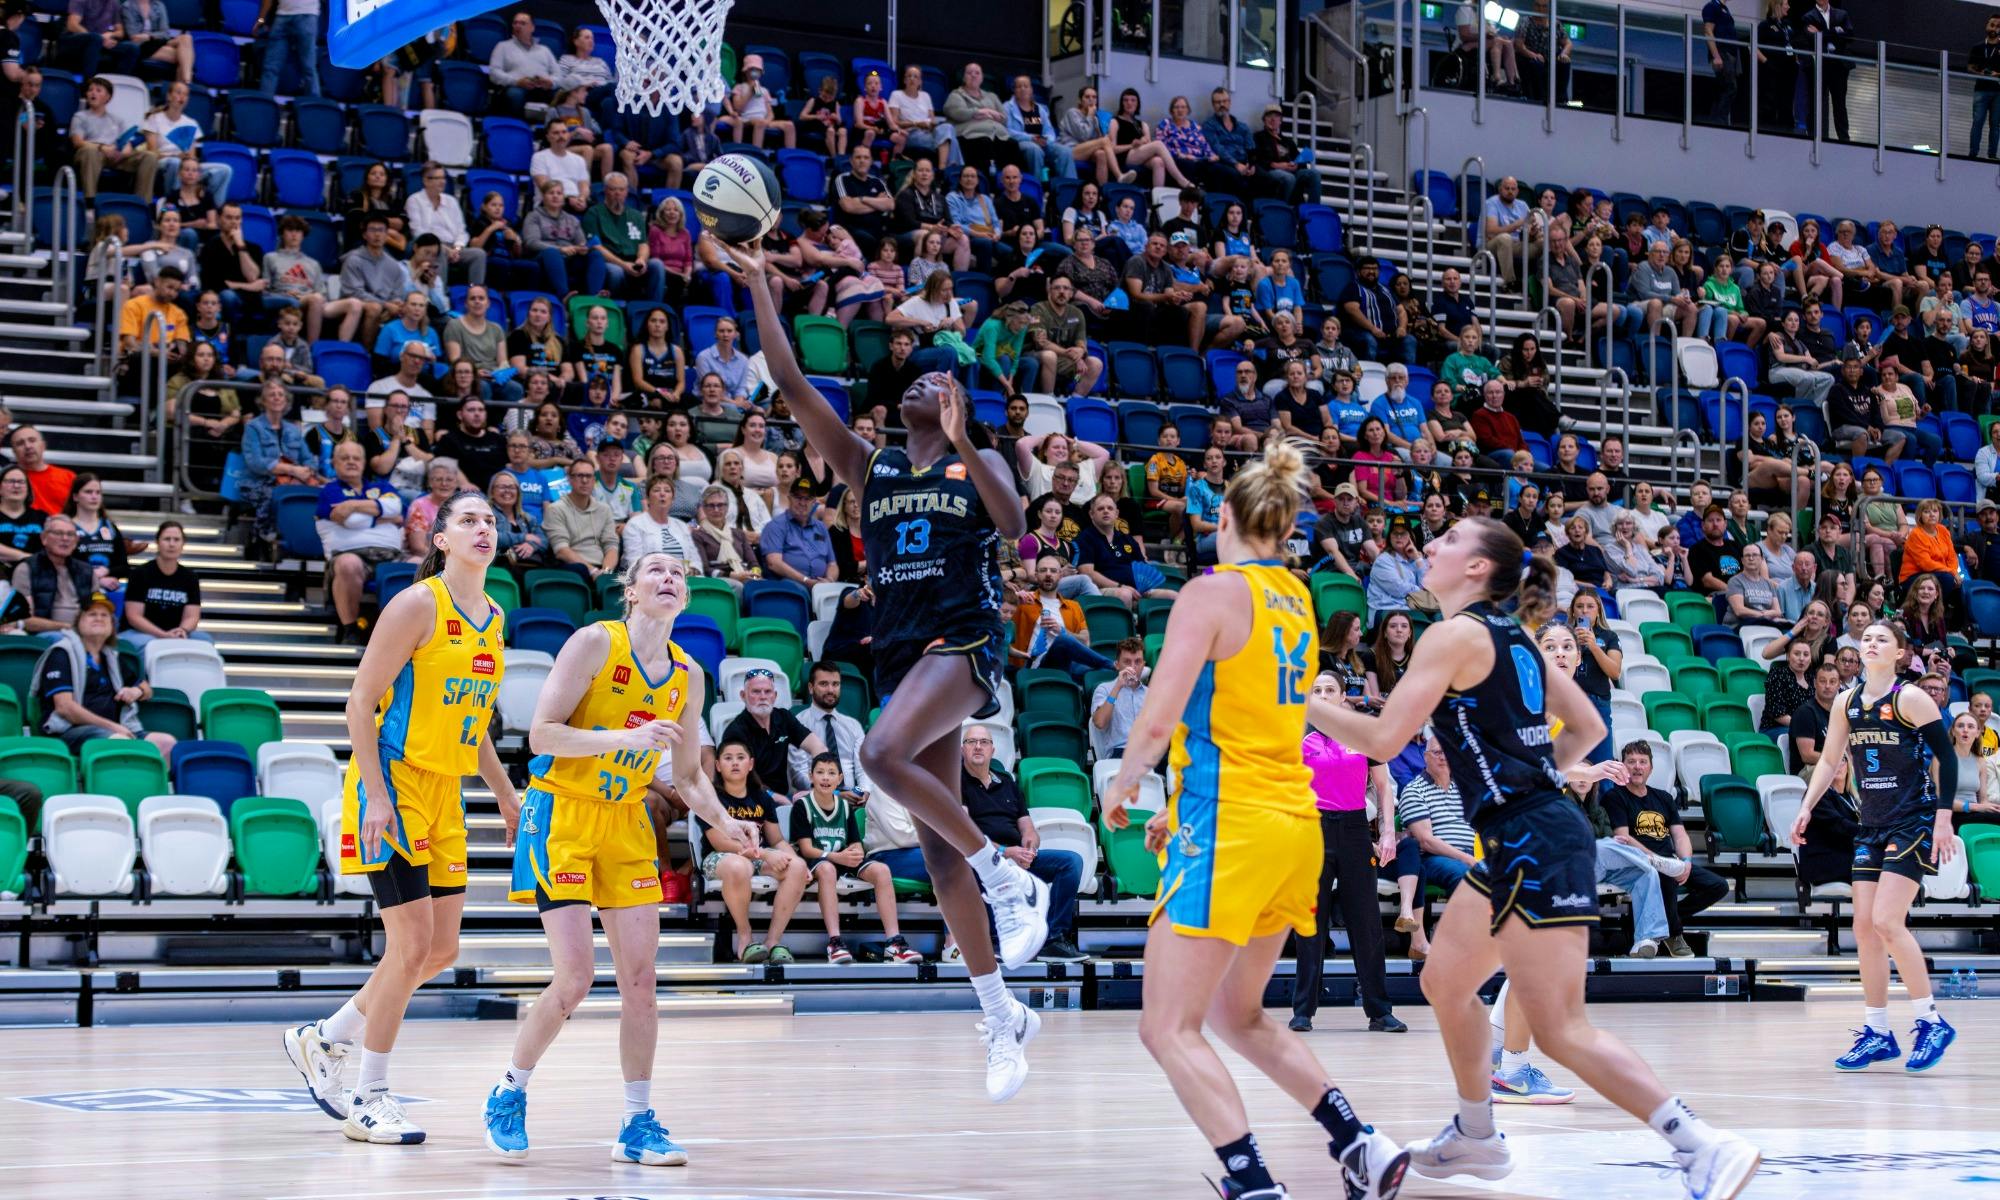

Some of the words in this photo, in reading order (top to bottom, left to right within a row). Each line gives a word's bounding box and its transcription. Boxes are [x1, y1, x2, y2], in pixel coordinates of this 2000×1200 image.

[869, 493, 968, 523] CAPITALS
[895, 519, 931, 554] 13
[148, 588, 162, 600] UC
[163, 589, 187, 604] CAPS
[473, 659, 494, 669] CHEMIST
[1509, 644, 1543, 715] 0
[1866, 749, 1880, 773] 5
[598, 770, 628, 801] 32
